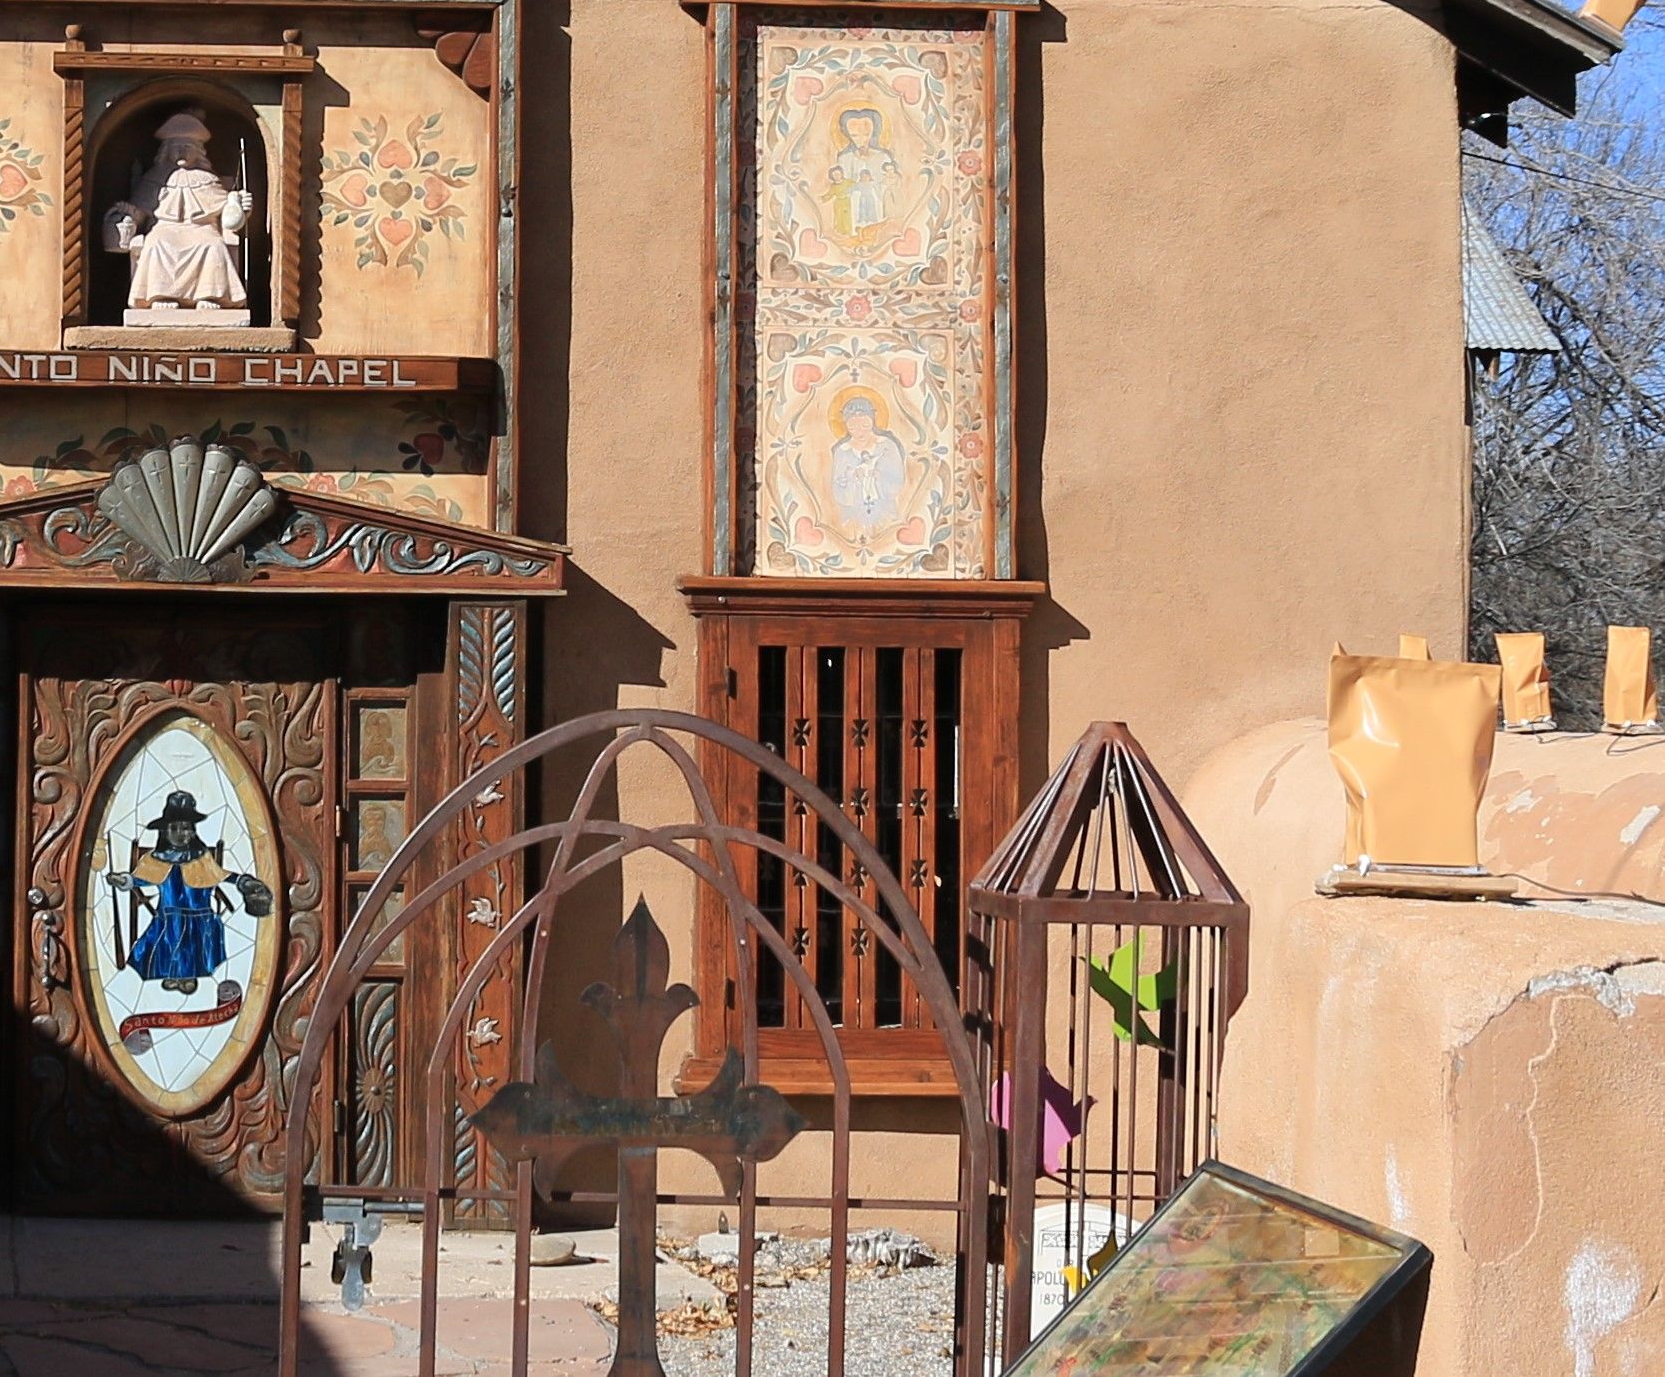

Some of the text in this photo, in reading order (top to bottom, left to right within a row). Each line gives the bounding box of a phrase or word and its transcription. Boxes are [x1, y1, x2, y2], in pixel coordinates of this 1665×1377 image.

[108, 355, 216, 382] NIÑO
[244, 358, 417, 386] CHAPEL
[124, 1016, 166, 1032] Santo
